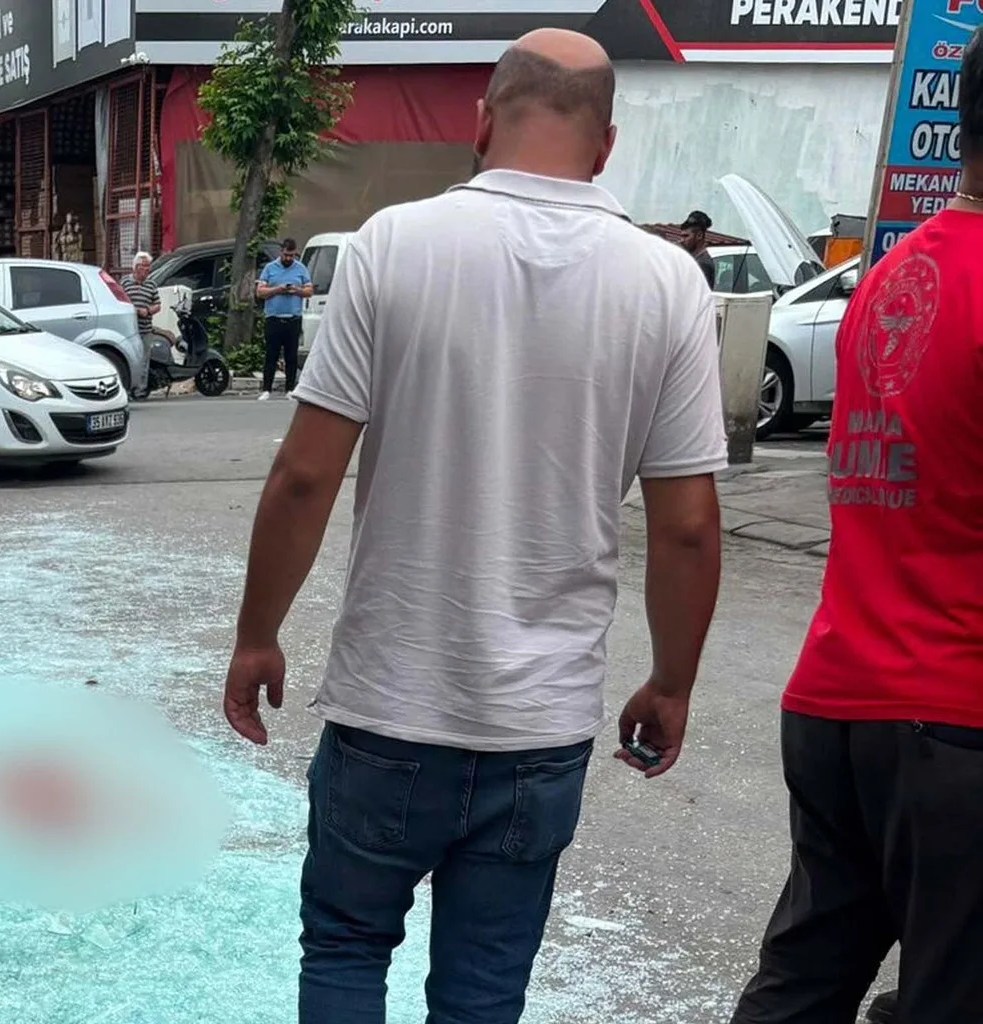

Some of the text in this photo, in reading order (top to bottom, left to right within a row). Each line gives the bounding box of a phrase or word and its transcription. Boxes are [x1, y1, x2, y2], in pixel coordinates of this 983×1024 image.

[2, 10, 14, 36] ve
[730, 0, 901, 25] PERAKEND
[338, 17, 453, 38] arakakapi.com
[932, 40, 963, 59] ÖZ
[4, 43, 31, 85] SATIŞ
[911, 196, 950, 214] YED
